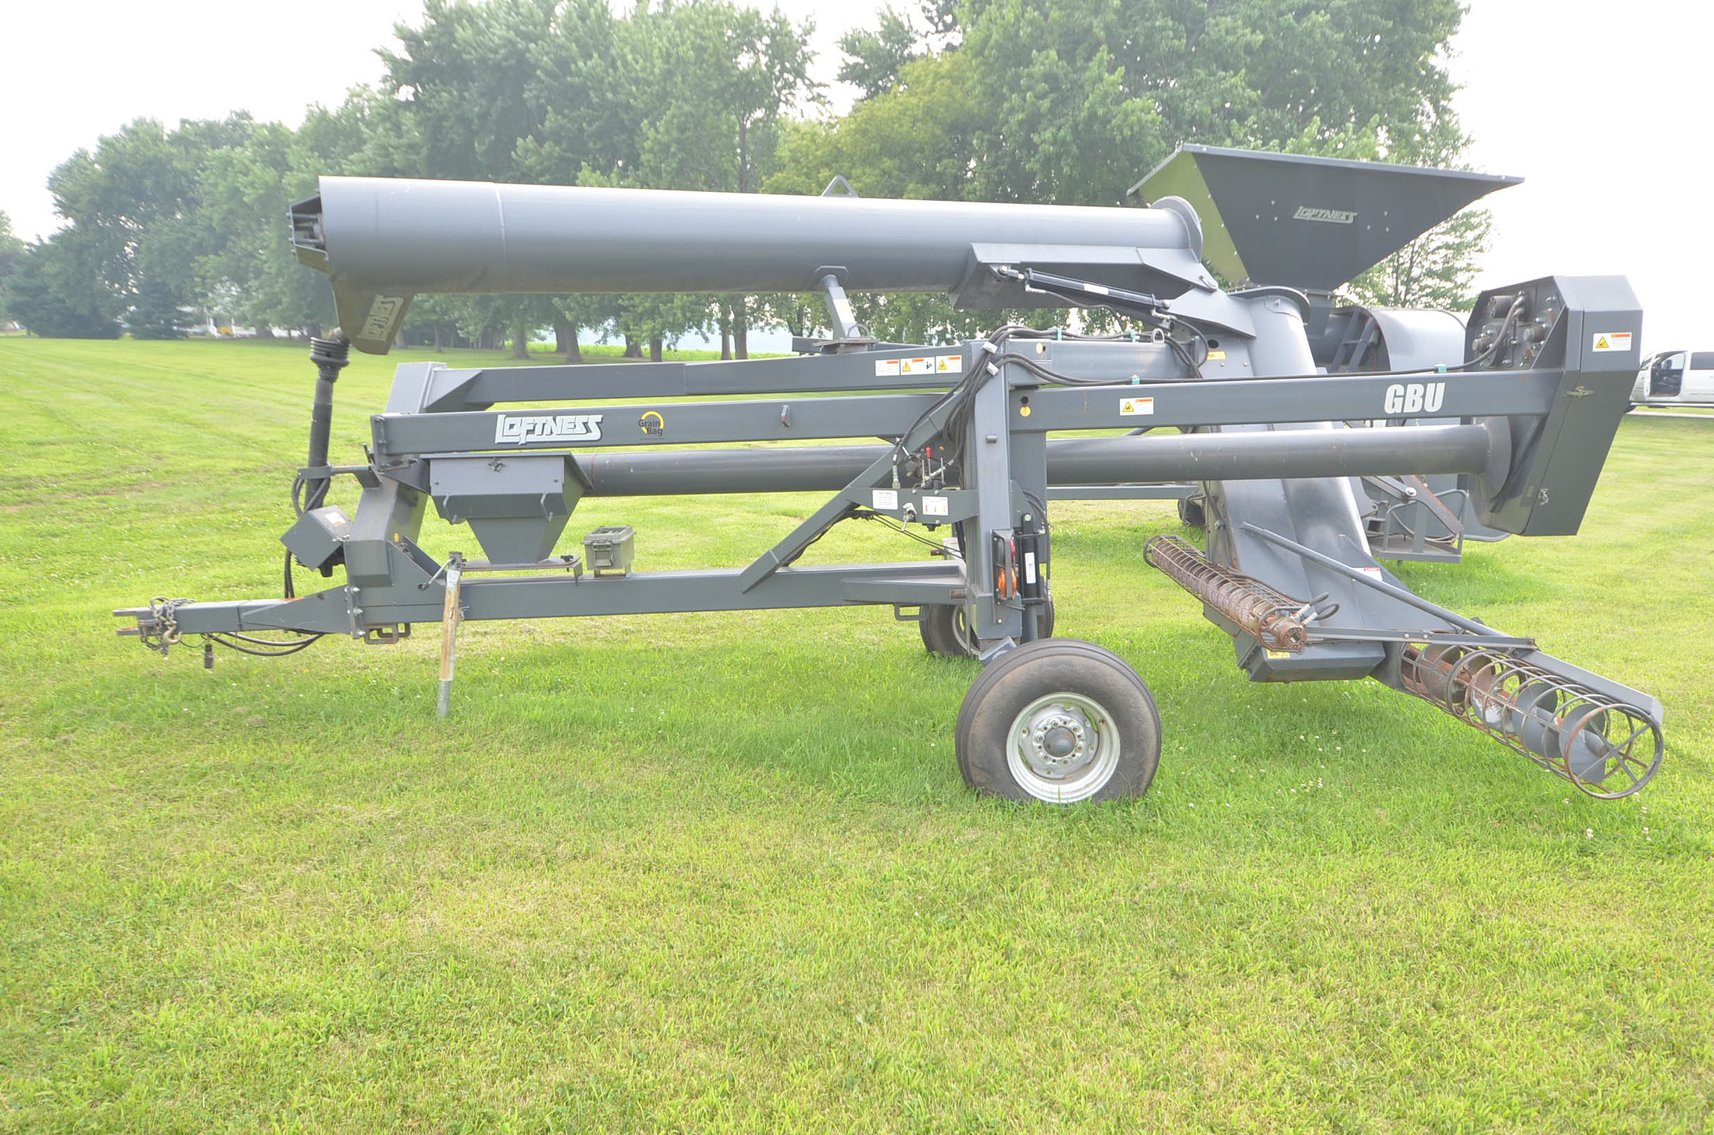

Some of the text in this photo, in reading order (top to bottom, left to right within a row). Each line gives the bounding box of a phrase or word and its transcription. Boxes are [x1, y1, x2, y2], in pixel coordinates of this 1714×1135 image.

[1293, 206, 1358, 224] LOFTNESS
[1384, 382, 1446, 415] GBU
[495, 414, 603, 445] LOFTNESS
[638, 418, 660, 428] Grain
[646, 427, 663, 437] Bag
